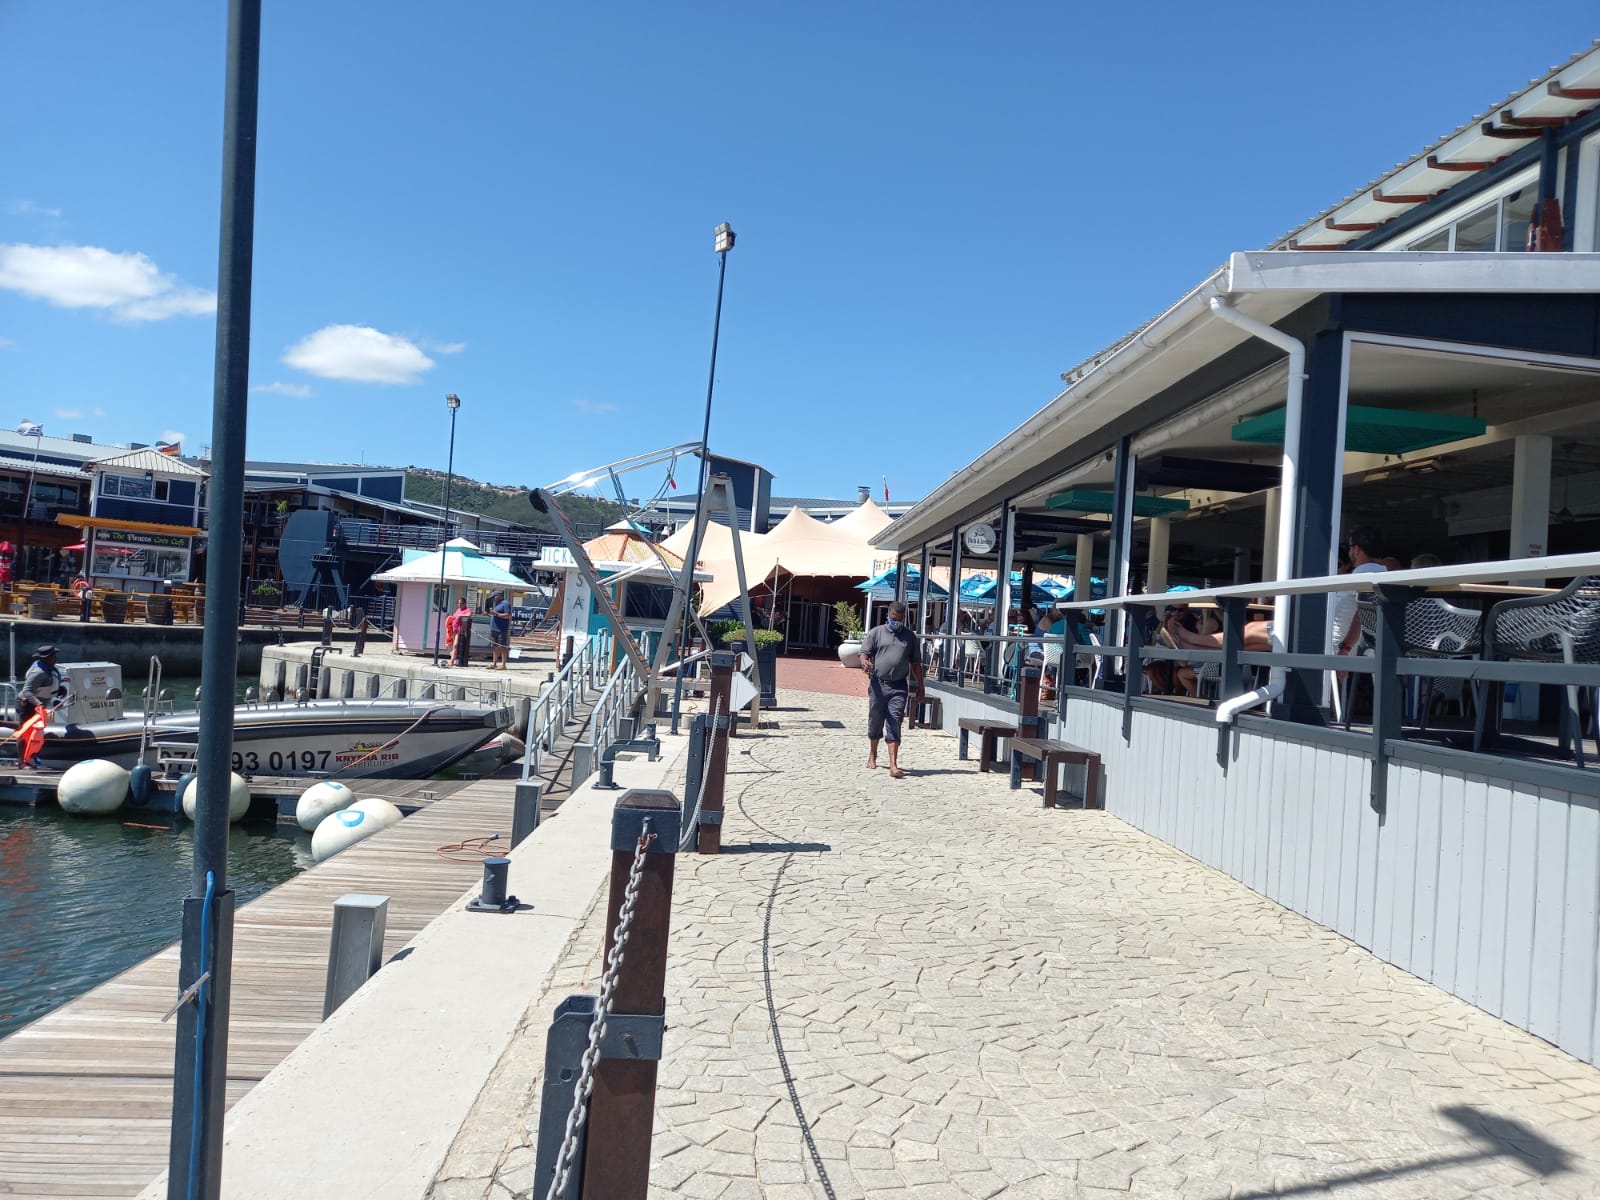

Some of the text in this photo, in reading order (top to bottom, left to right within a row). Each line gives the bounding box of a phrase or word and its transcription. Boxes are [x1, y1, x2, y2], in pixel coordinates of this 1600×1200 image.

[543, 548, 587, 565] TICK
[517, 610, 544, 620] Festials
[269, 750, 332, 771] 0197
